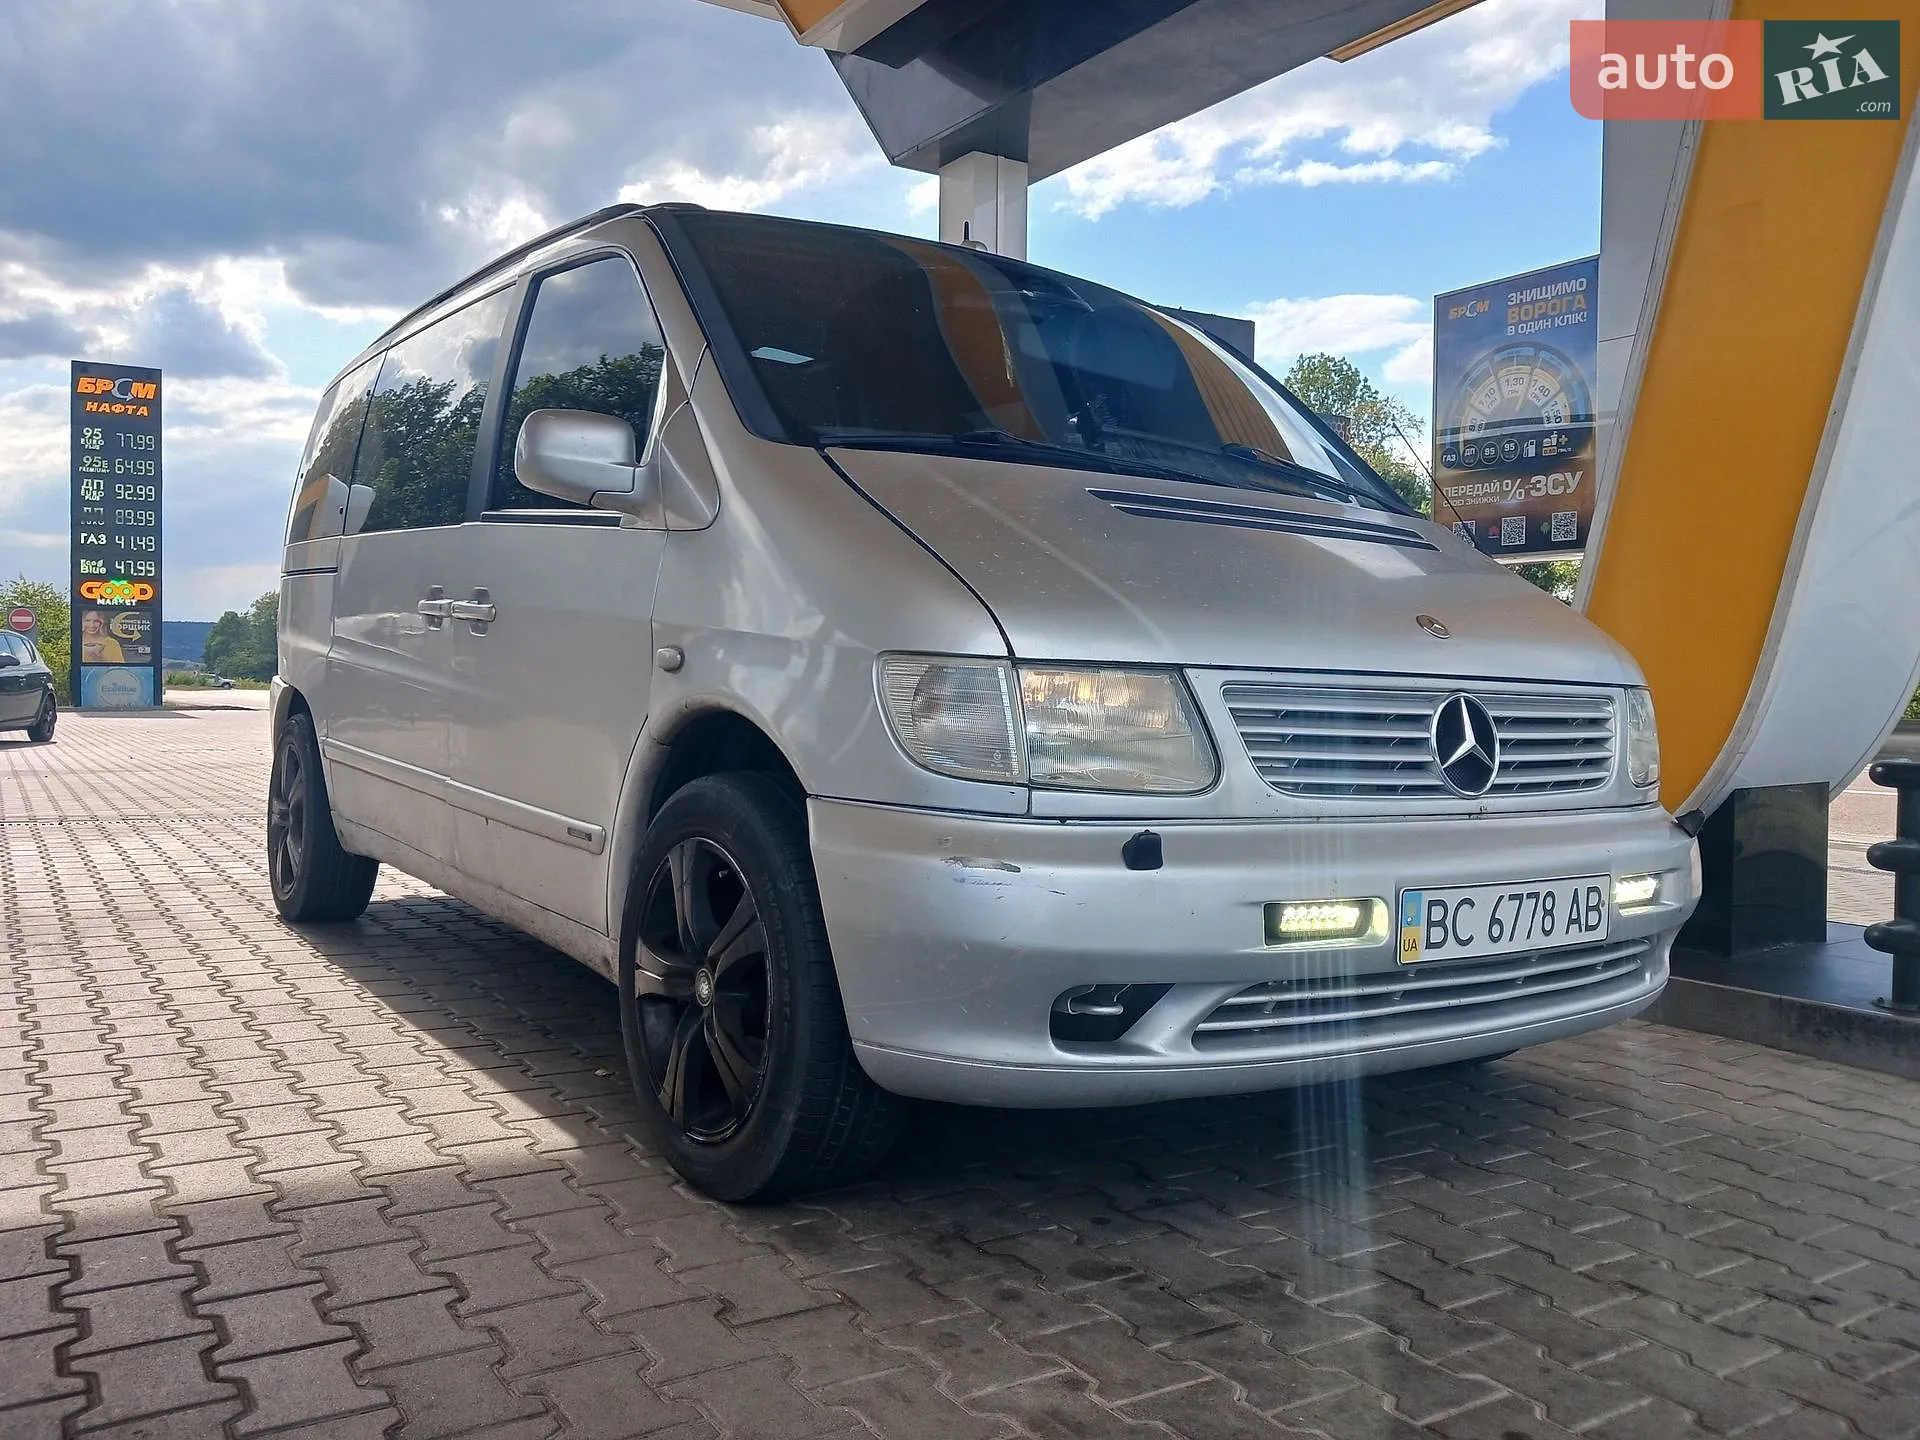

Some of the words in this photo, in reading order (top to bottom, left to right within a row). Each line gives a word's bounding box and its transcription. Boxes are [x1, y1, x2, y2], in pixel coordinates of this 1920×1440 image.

[1507, 277, 1587, 306] ЗНИЩИМО
[1507, 294, 1587, 324] ВОРОГА
[1507, 325, 1515, 336] В
[1518, 318, 1552, 335] ОДИН
[1555, 311, 1587, 328] КЛІК!
[76, 377, 157, 402] БРСМ
[85, 401, 149, 417] НАФТА
[80, 438, 104, 446] EURO
[83, 427, 102, 440] 95
[116, 432, 155, 450] 77.99
[1504, 441, 1516, 452] 95
[115, 458, 155, 475] 64.99
[1442, 453, 1456, 463] ГАЗ
[81, 479, 104, 490] ДП
[115, 483, 155, 501] 92.99
[1443, 479, 1500, 499] ПЕРЕДАЙ
[1530, 470, 1583, 498] ЗСУ
[1466, 496, 1500, 506] ЗНИЖКИ
[80, 532, 107, 545] ГАЗ
[115, 535, 155, 552] 41.49
[115, 560, 155, 577] 47.99
[80, 581, 154, 601] GOOD
[96, 598, 138, 606] MARKET
[1425, 899, 1475, 950] BC
[1487, 890, 1556, 944] 6778
[1565, 886, 1603, 936] AB
[1403, 938, 1418, 952] UA
